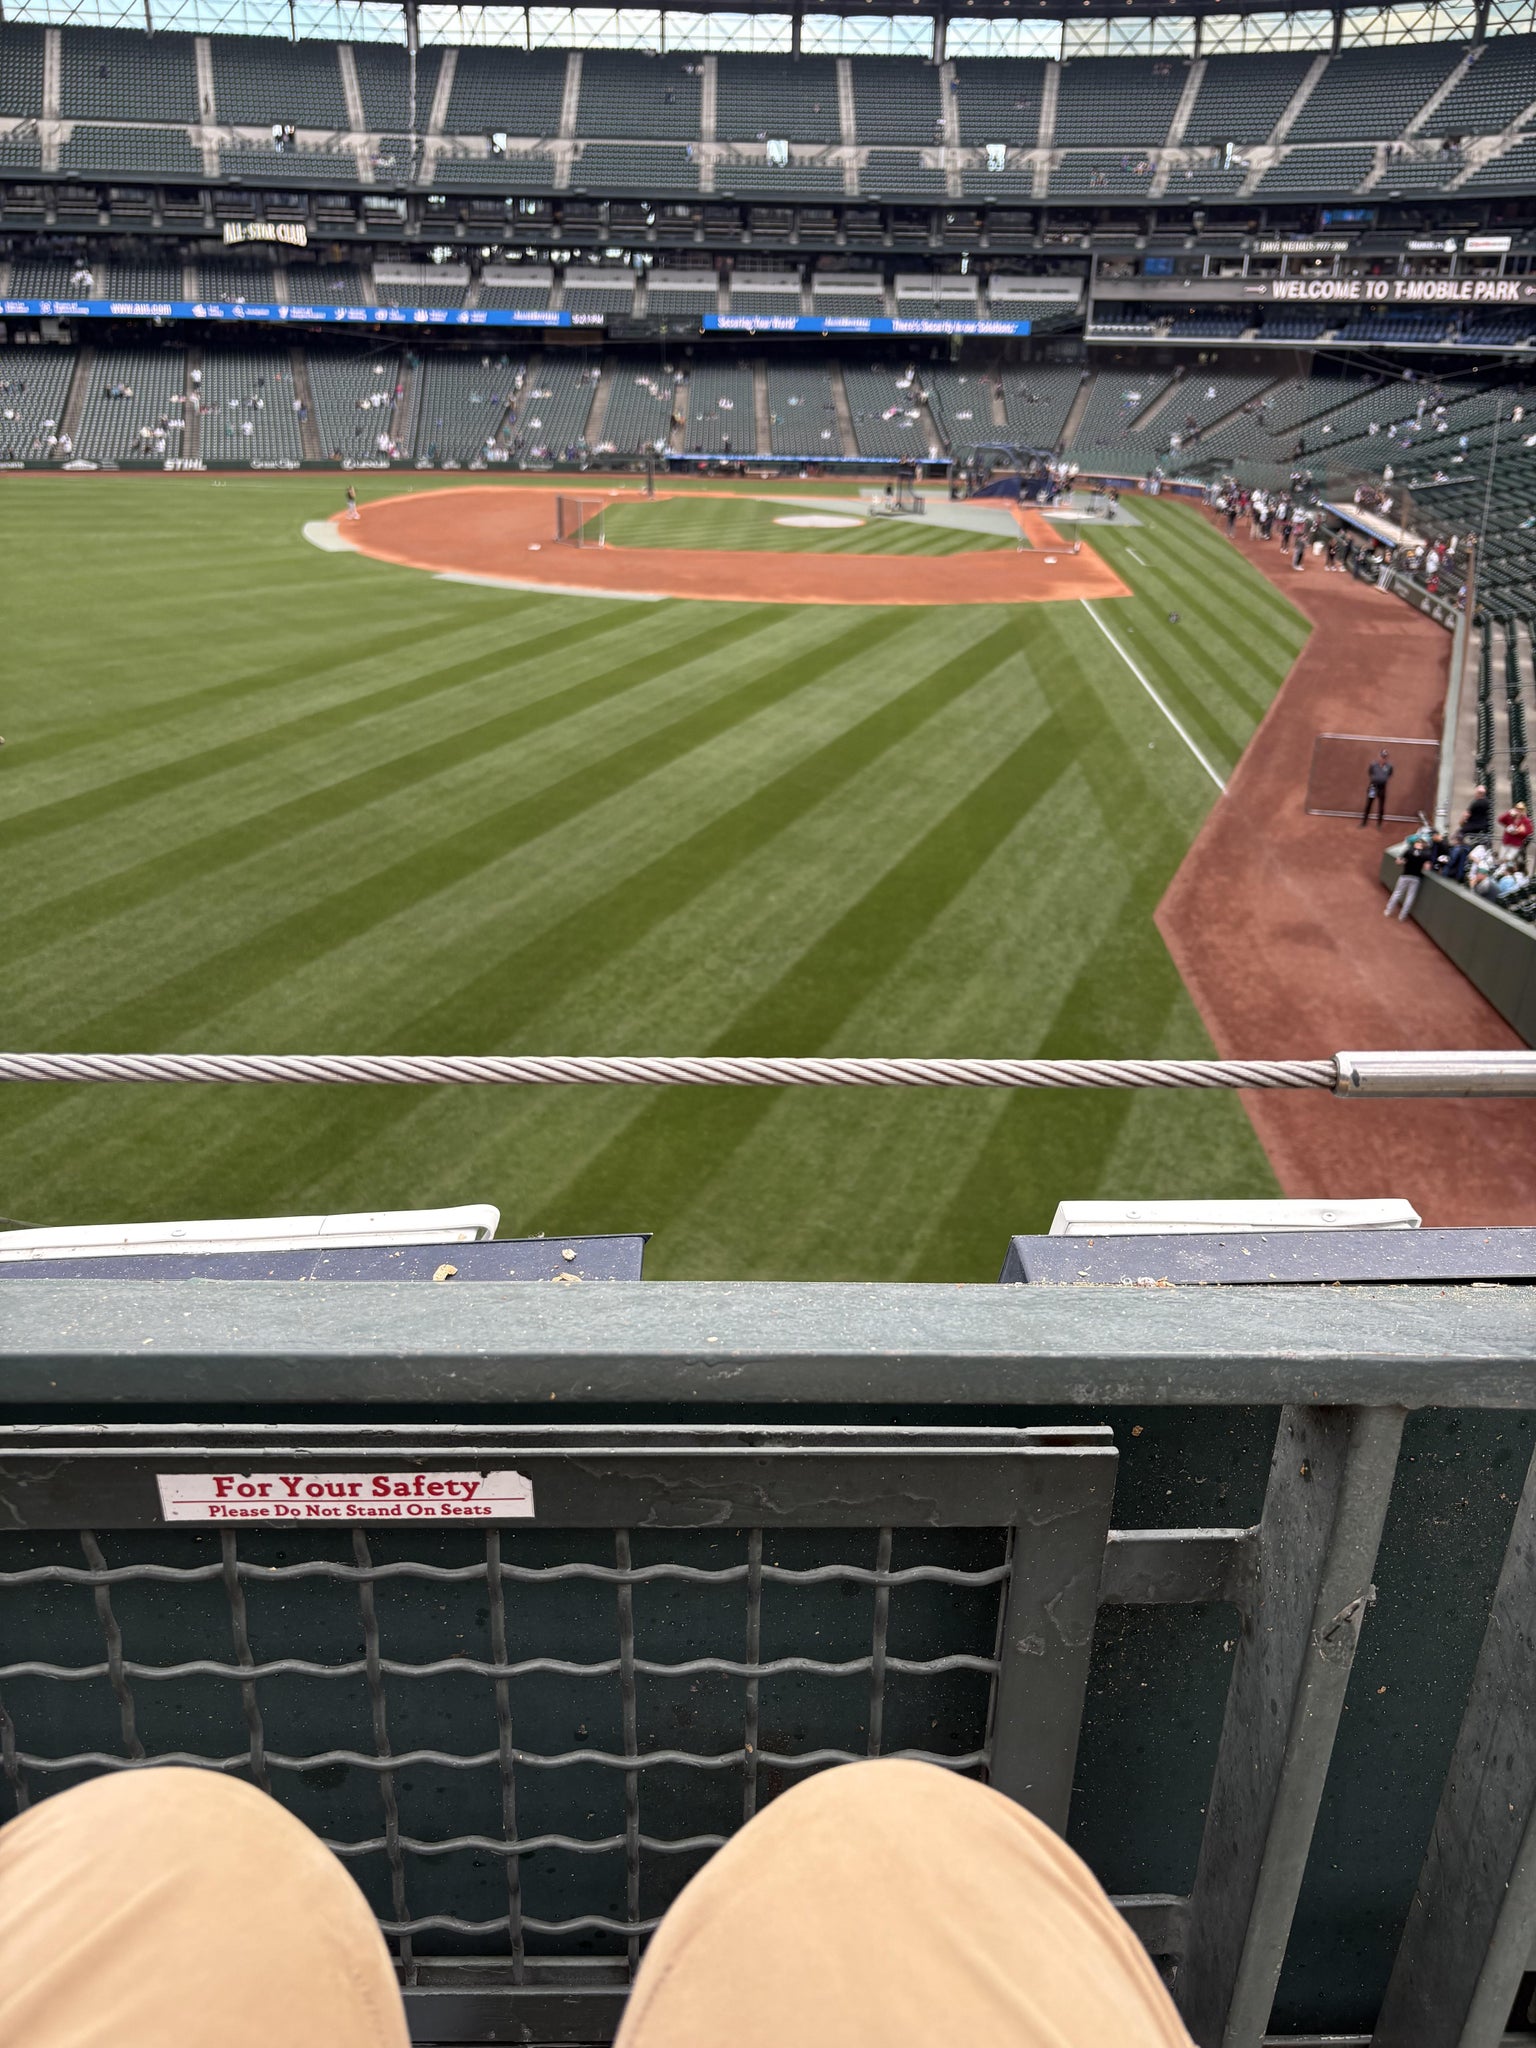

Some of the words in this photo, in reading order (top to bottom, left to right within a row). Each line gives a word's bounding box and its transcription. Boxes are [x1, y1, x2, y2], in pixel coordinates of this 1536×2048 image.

[276, 223, 307, 247] CLUB
[1272, 280, 1361, 299] WELCOME
[1365, 280, 1389, 300] TO
[1473, 281, 1522, 300] PARK
[163, 458, 207, 471] STIHL
[213, 1476, 272, 1498] For
[279, 1476, 362, 1498] Your
[372, 1475, 481, 1502] Safety
[208, 1505, 270, 1518] Please
[274, 1504, 300, 1517] Do
[306, 1505, 342, 1517] Not
[346, 1504, 402, 1516] Stand
[407, 1503, 436, 1516] On
[441, 1503, 492, 1516] Seats
